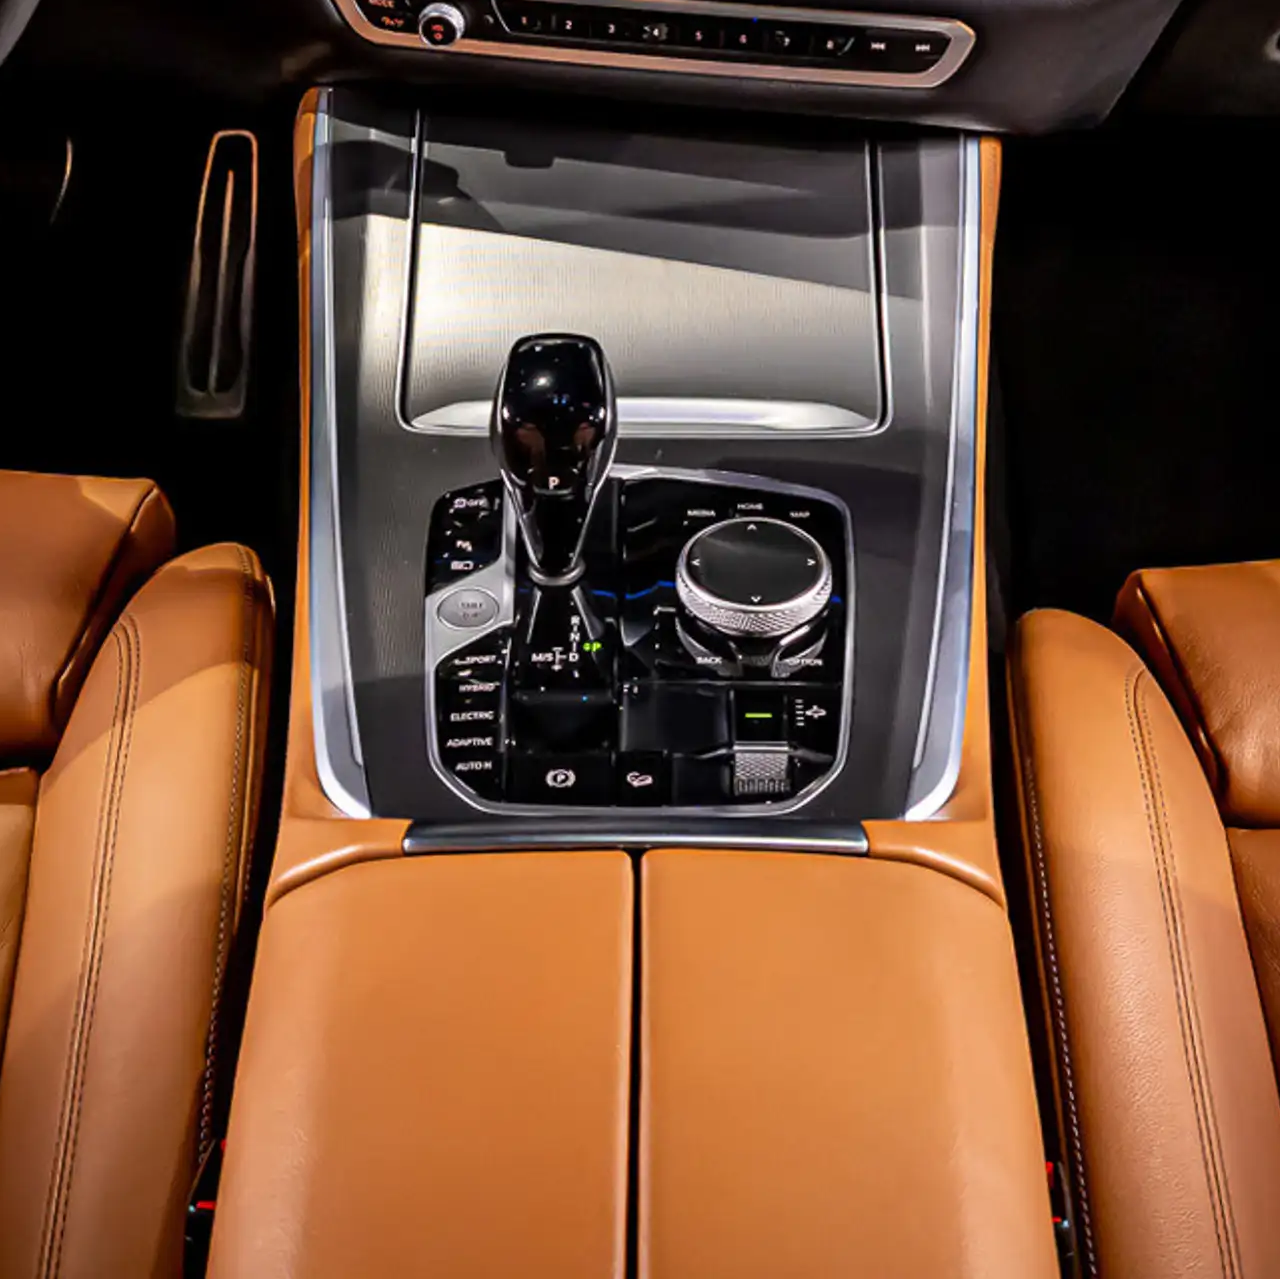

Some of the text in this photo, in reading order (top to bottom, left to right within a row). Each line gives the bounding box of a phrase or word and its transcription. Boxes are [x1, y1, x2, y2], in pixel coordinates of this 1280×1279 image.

[548, 476, 559, 490] P
[450, 711, 494, 722] ELECTRIC
[446, 736, 493, 748] ADAPTIVE
